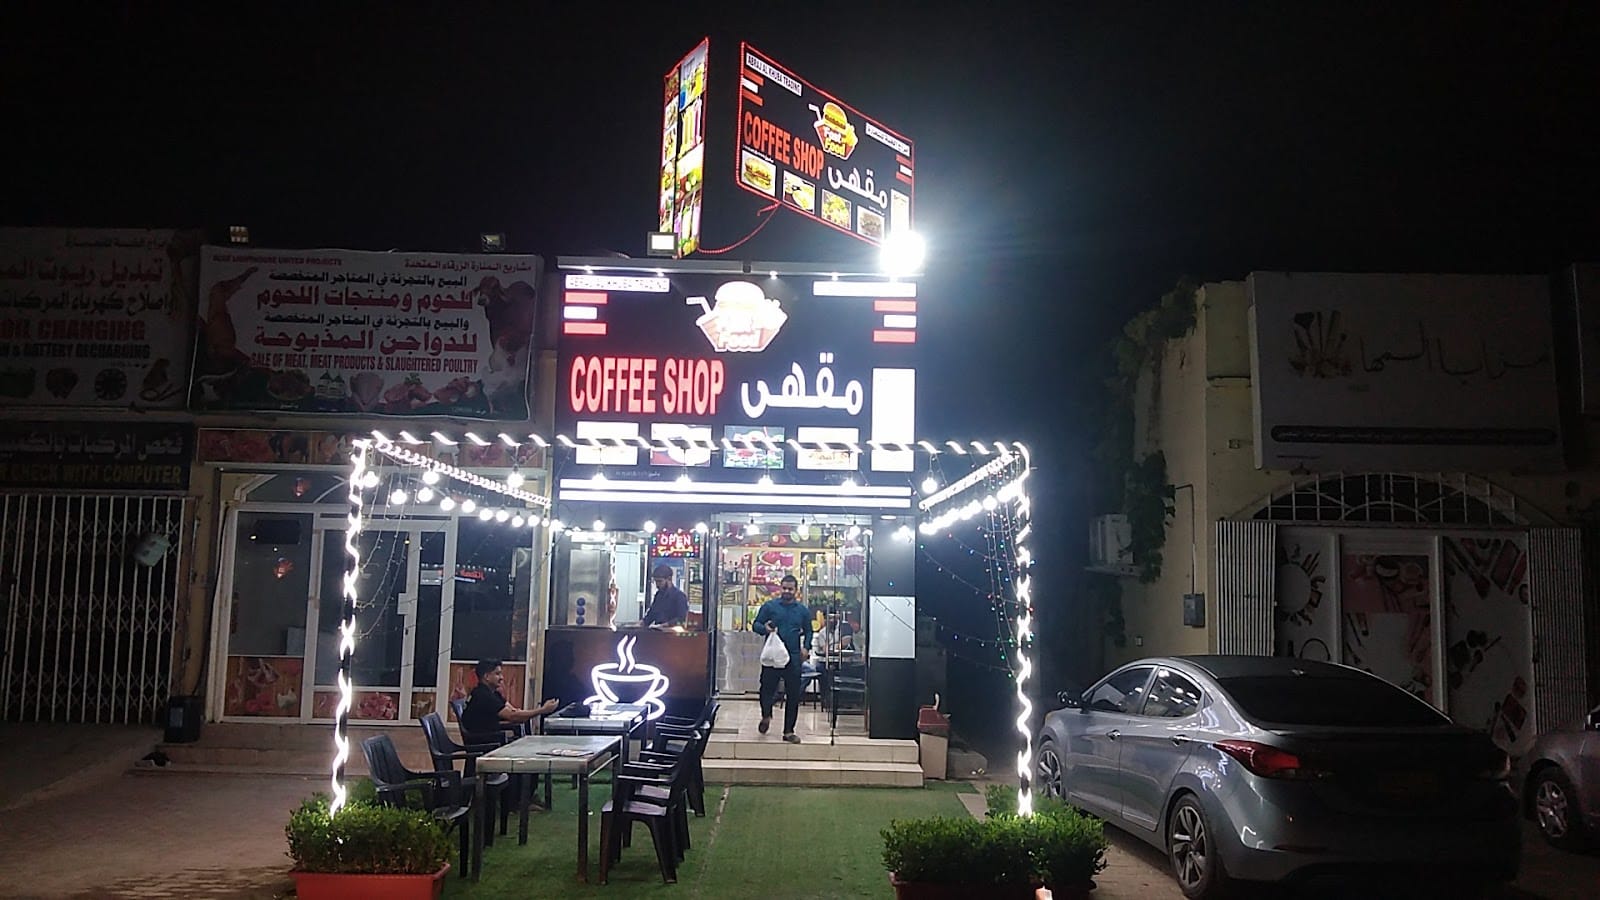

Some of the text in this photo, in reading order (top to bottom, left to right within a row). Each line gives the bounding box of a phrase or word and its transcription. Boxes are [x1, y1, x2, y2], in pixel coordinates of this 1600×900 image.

[743, 111, 792, 165] COFFEE
[793, 137, 824, 180] SHOP
[825, 138, 846, 156] Food
[827, 165, 888, 209] مقهى
[257, 285, 319, 310] اللحوم
[37, 319, 145, 341] CHANGING
[254, 326, 477, 356] للدواجن المذبوحة
[252, 352, 272, 368] SALE
[273, 353, 283, 367] OF
[310, 354, 332, 369] MEAT
[334, 355, 376, 370] PRODUCTS
[377, 357, 383, 370] &
[385, 357, 441, 372] SLAUGHTERED
[443, 359, 478, 373] POULTRY
[570, 355, 725, 416] COFFEE SHOP
[740, 352, 864, 419] مقهى
[64, 464, 99, 482] WITH
[103, 464, 182, 484] COMPUTER
[660, 533, 691, 546] OPEN
